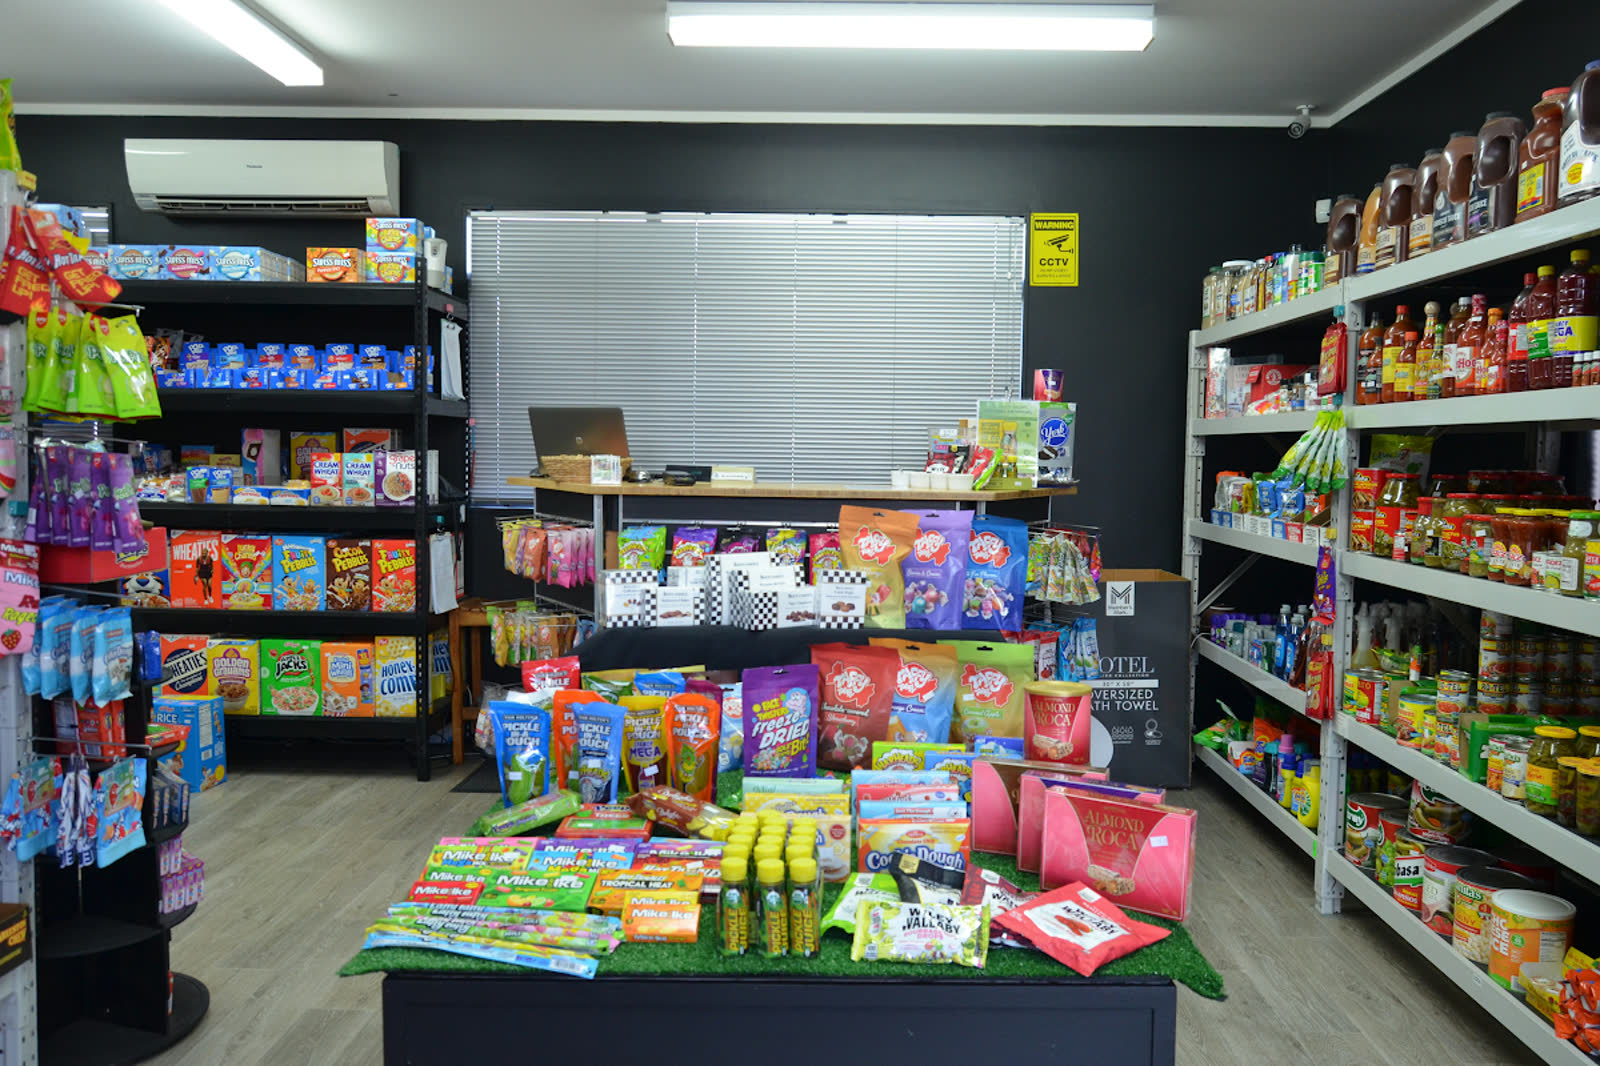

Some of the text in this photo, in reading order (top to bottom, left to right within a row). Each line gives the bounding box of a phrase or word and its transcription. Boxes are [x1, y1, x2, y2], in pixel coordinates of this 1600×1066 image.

[1035, 221, 1074, 230] WARNING
[1039, 258, 1069, 266] CCTV
[170, 651, 207, 678] HEATIES
[214, 658, 250, 669] GOLDEN
[275, 658, 308, 679] JACKS
[1100, 657, 1155, 674] OTEL
[213, 667, 251, 678] GRAHAMS
[761, 698, 780, 710] FACE
[1034, 701, 1076, 713] ALMOND
[1115, 701, 1159, 711] TOWEL
[156, 713, 177, 723] RICE
[756, 706, 789, 721] TWISTERS
[1035, 711, 1072, 727] ROCA
[503, 722, 540, 731] PICKLE
[751, 711, 800, 737] freeze
[759, 719, 810, 749] DRIED
[506, 737, 540, 746] OUCH
[580, 739, 610, 749] OUCH
[629, 747, 661, 760] MEGA
[1085, 810, 1145, 833] ALMOND
[1086, 824, 1138, 850] ROCA
[442, 851, 486, 861] Mike
[544, 857, 617, 868] Mike Ike
[917, 846, 964, 869] Dough
[430, 872, 486, 882] Mike Ike
[497, 875, 584, 889] Mike Ike
[414, 886, 472, 896] Mike Ike
[600, 880, 674, 889] TROPICAL HEAT
[631, 897, 667, 905] Mike
[632, 909, 694, 919] Mike Ike
[909, 908, 953, 924] WLEY
[729, 908, 739, 951] PICKLE
[739, 908, 748, 949] JUICE
[772, 911, 781, 953] PICKLE
[780, 909, 789, 950] JUICE
[794, 908, 804, 952] PICKLE
[804, 907, 815, 952] JUICE
